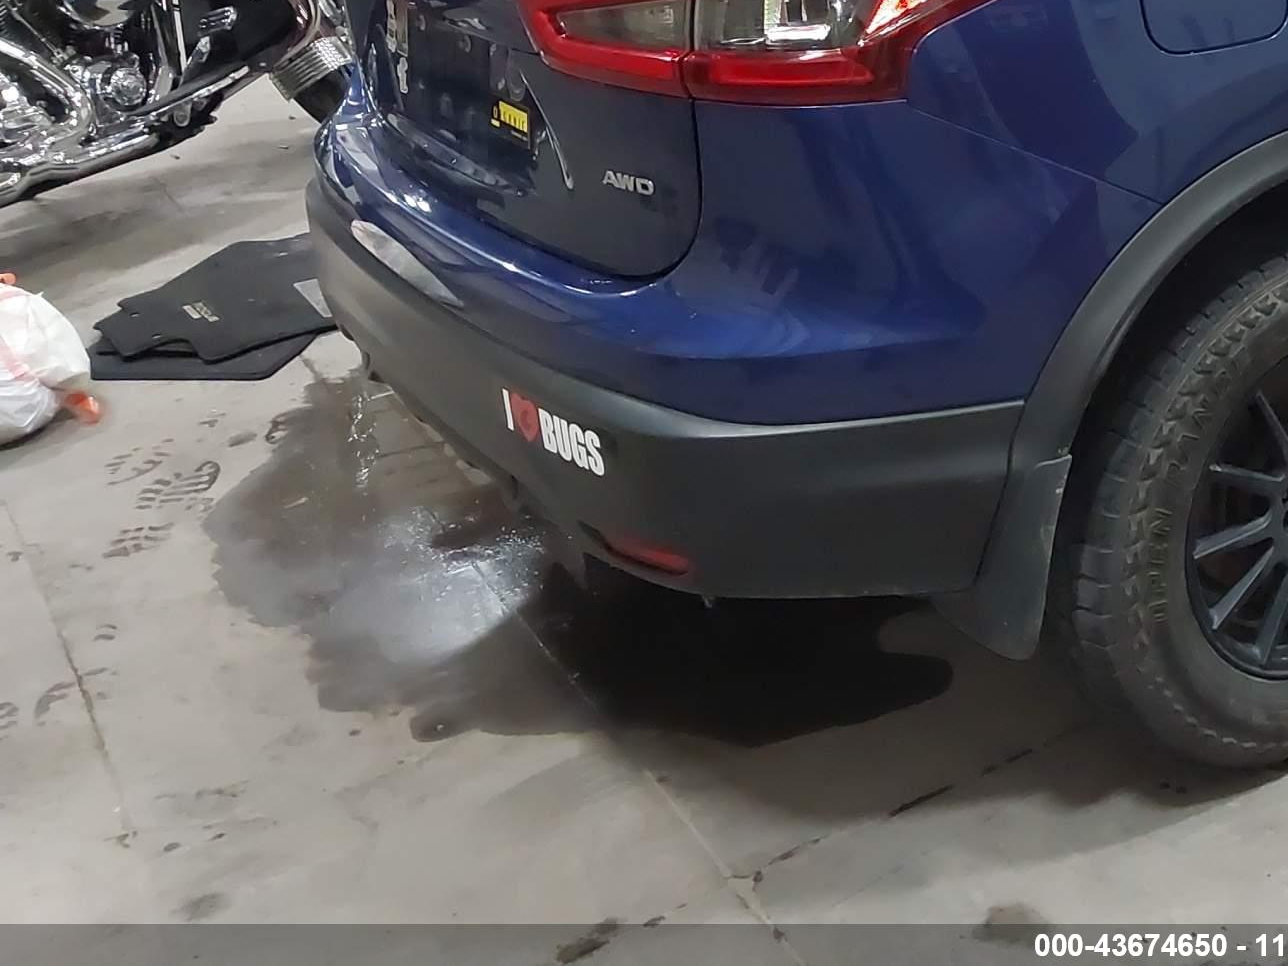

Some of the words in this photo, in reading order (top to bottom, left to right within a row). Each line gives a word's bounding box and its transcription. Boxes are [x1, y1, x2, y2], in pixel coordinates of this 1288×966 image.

[602, 170, 654, 195] AWD
[502, 388, 514, 431] I
[538, 408, 605, 476] BUGS
